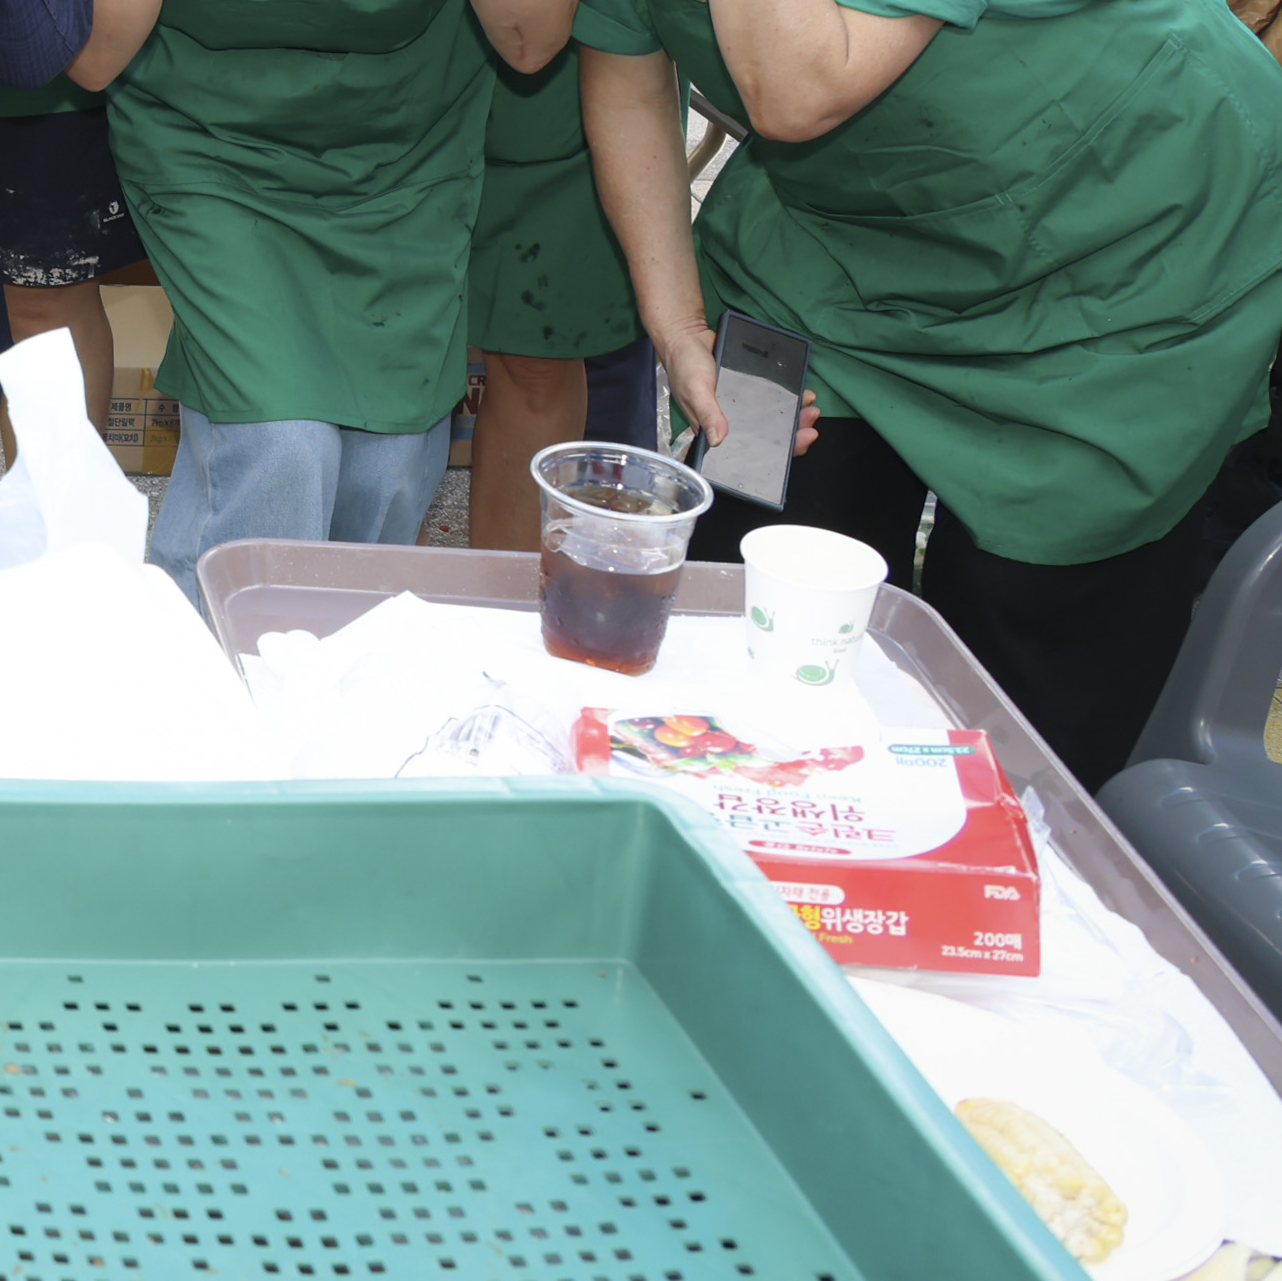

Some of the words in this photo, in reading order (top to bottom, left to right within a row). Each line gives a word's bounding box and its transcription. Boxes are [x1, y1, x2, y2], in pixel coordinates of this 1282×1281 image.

[713, 793, 866, 823] 위생장갑
[983, 884, 1022, 901] FDA
[973, 931, 1023, 950] 200매
[941, 945, 983, 960] 23.5cm
[992, 950, 1024, 962] 27cm
